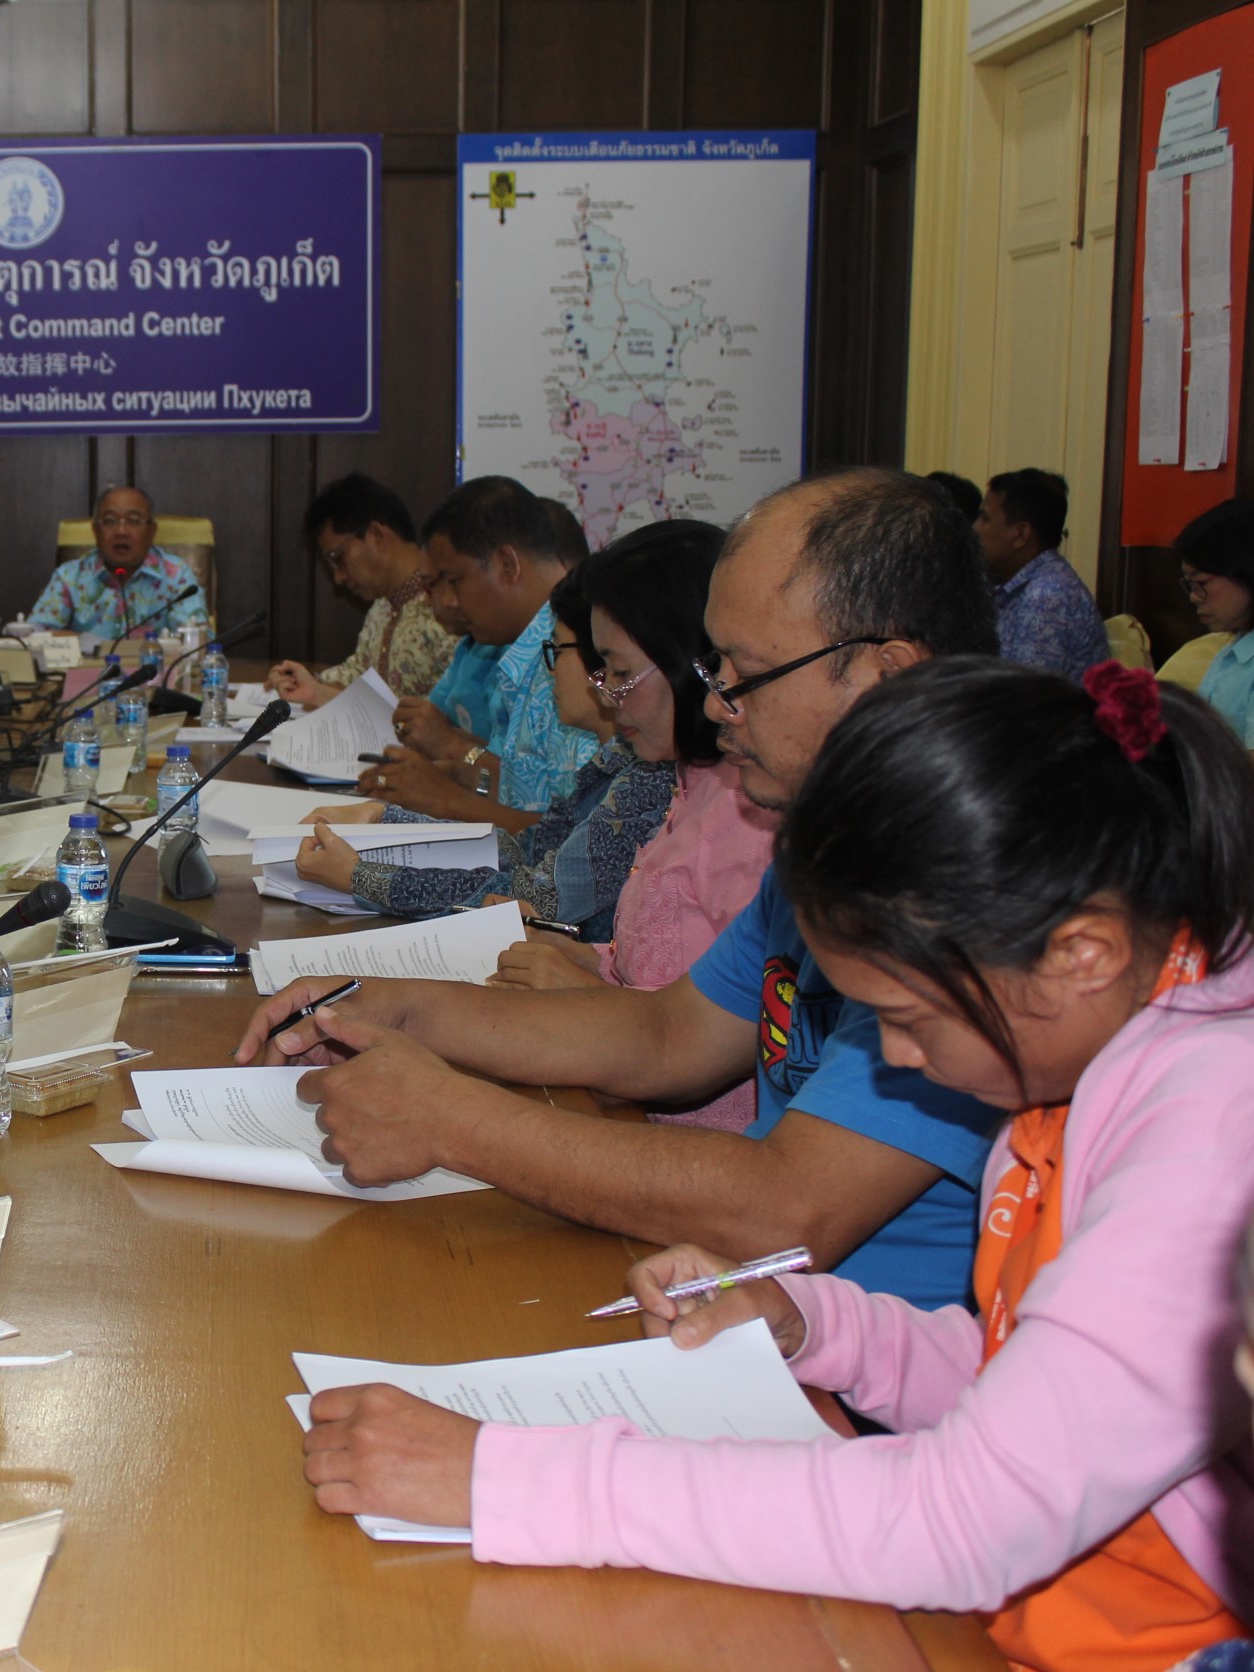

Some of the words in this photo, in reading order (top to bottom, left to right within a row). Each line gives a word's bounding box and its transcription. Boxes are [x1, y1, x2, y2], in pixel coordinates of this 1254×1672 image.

[129, 238, 340, 302] จังหวัดภูเก็ต
[9, 313, 136, 340] Command
[142, 311, 225, 337] Center
[112, 390, 217, 416] ситуации
[223, 384, 312, 415] Пхукета
